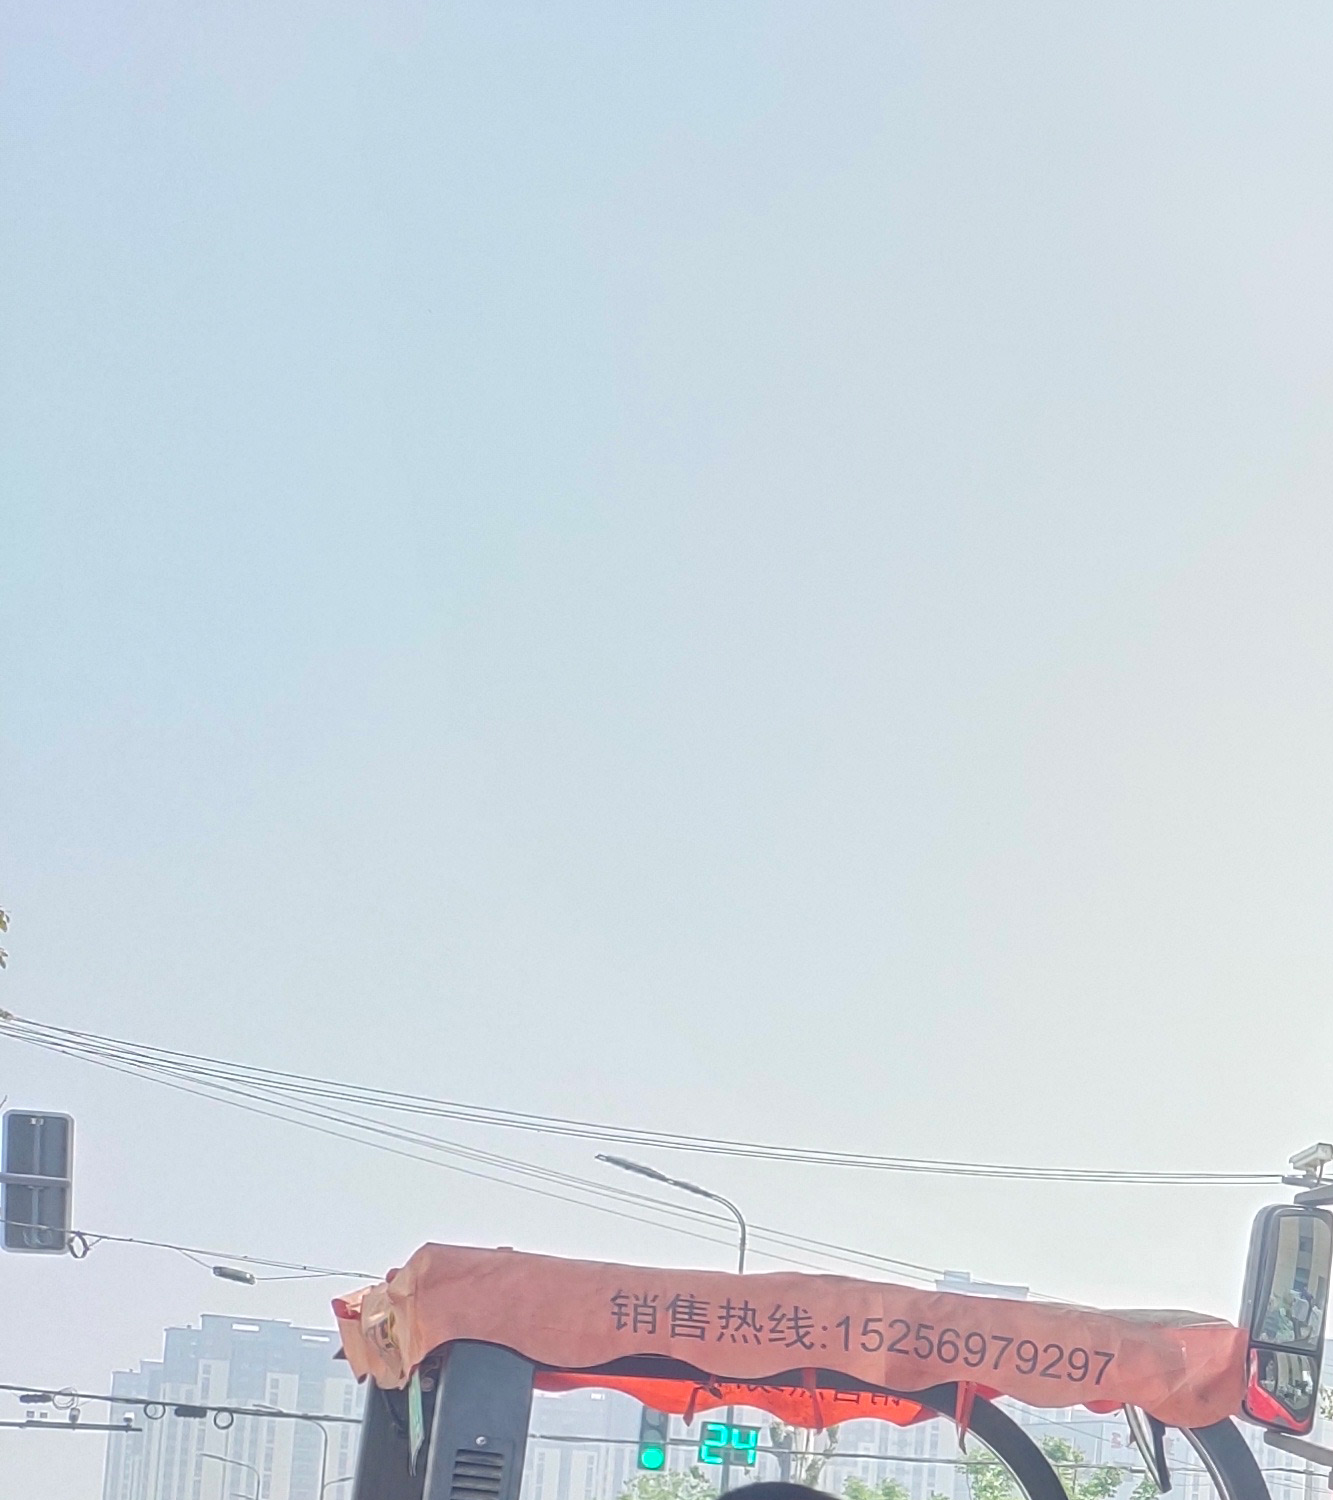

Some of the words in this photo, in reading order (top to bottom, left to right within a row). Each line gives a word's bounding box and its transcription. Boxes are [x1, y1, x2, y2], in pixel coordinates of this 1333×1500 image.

[611, 1288, 1115, 1386] 销售热线:15256979297
[701, 1424, 757, 1465] 24
